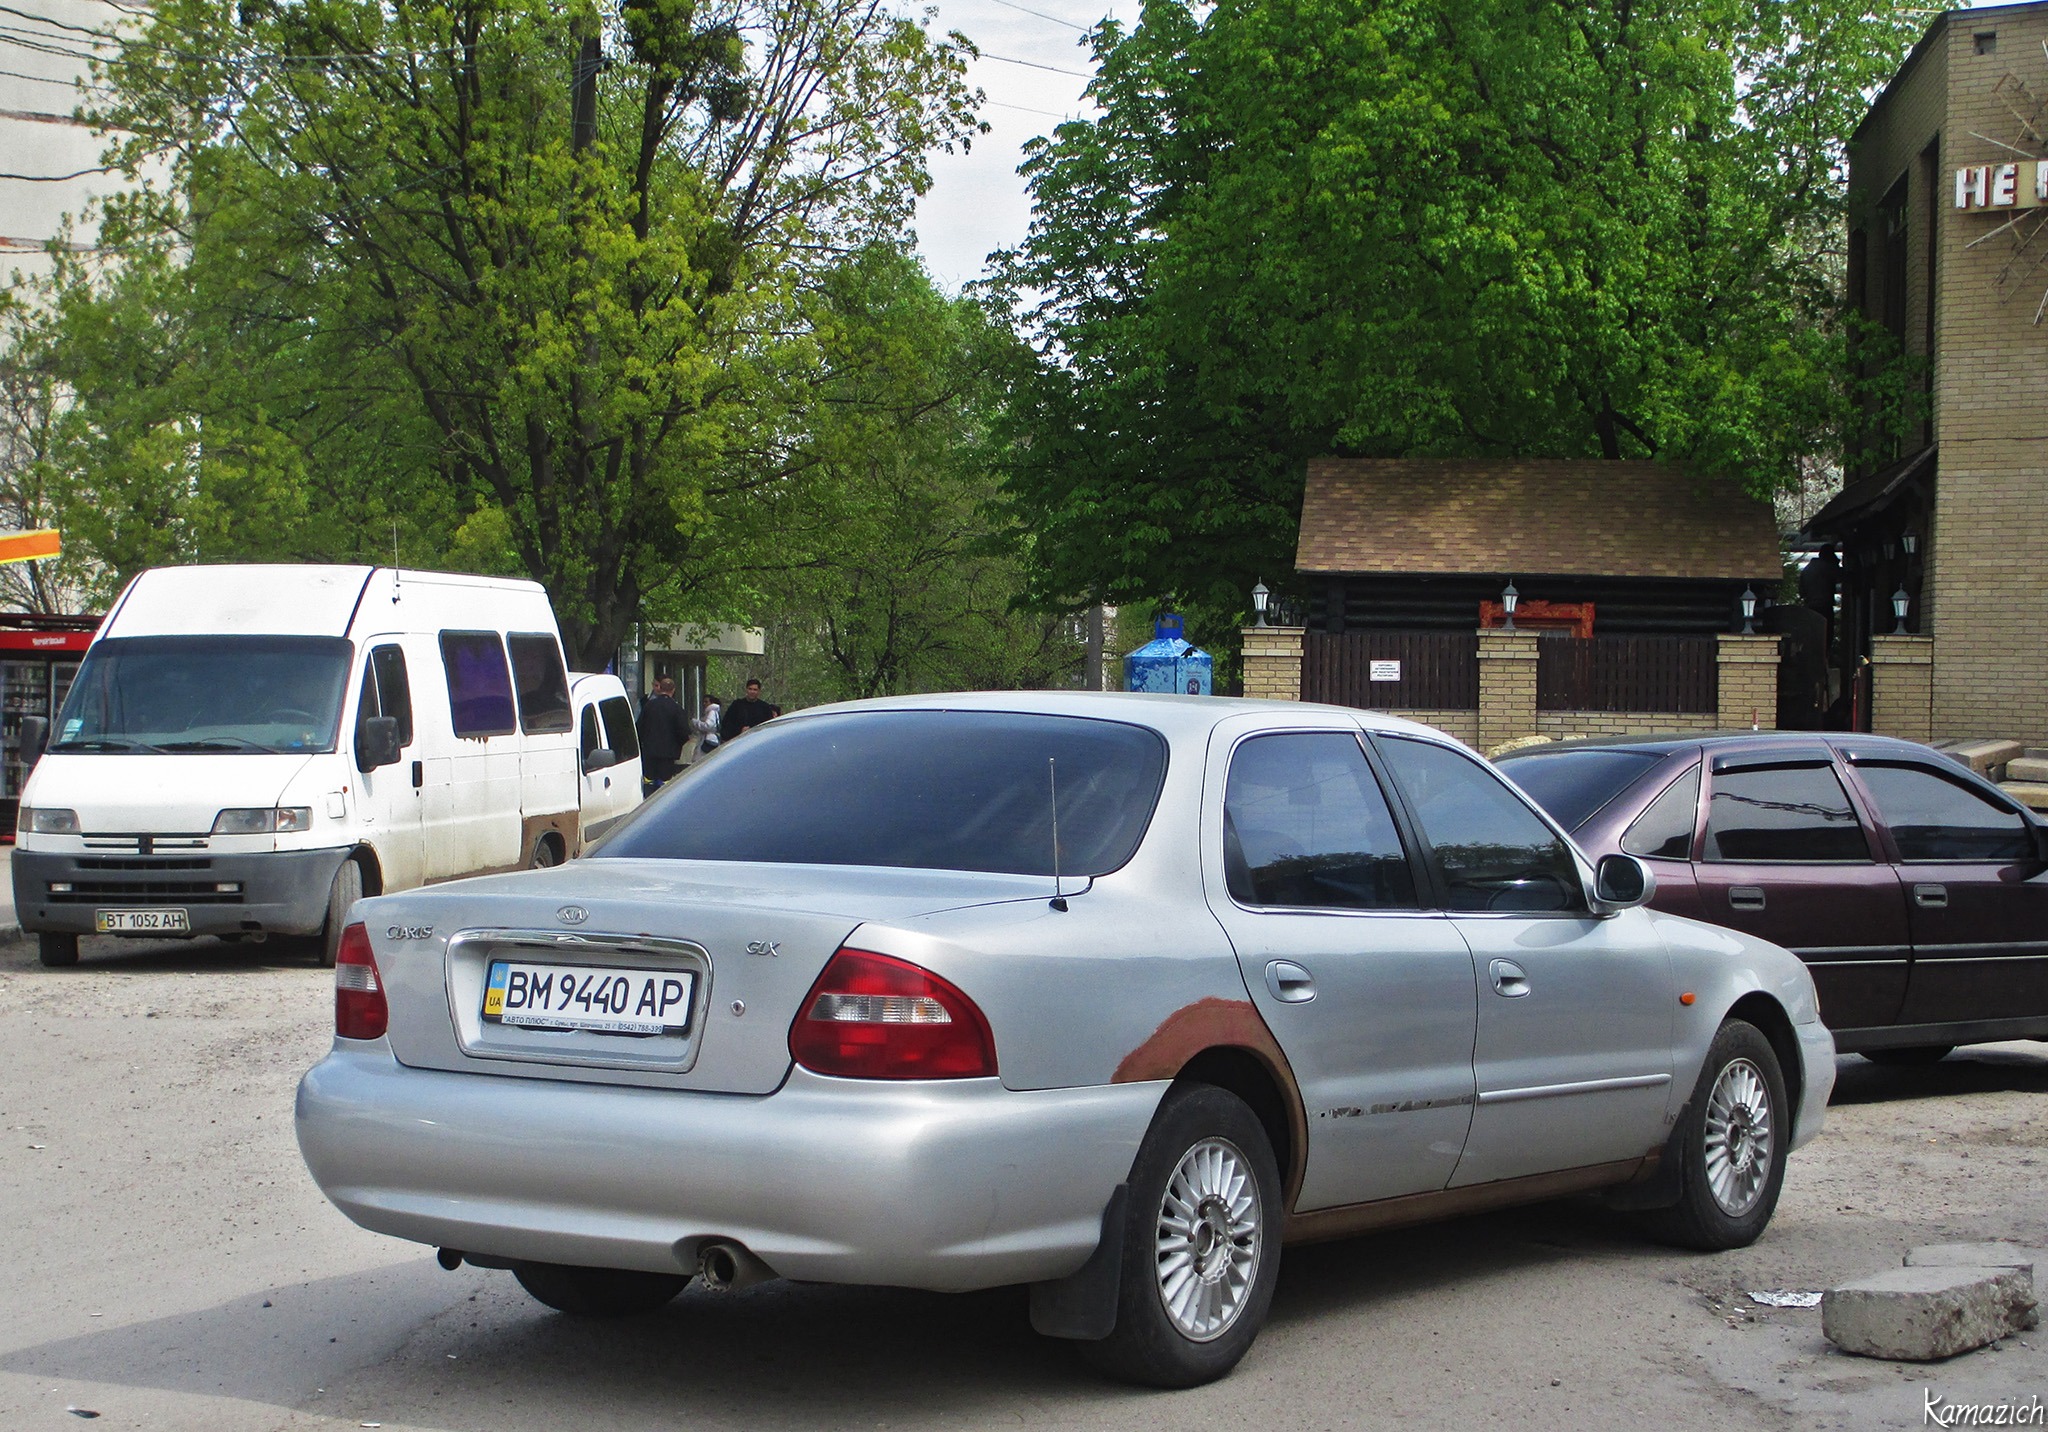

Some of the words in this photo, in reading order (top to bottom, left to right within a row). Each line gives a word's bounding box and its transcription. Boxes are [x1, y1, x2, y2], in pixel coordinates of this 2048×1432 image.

[106, 914, 125, 927] BT
[130, 914, 158, 927] 1052
[162, 914, 182, 927] AH
[562, 908, 584, 921] KIA
[746, 940, 781, 957] GLX
[506, 971, 553, 1010] BM
[558, 973, 630, 1014] 9440
[635, 978, 684, 1017] AP
[489, 997, 501, 1007] UA
